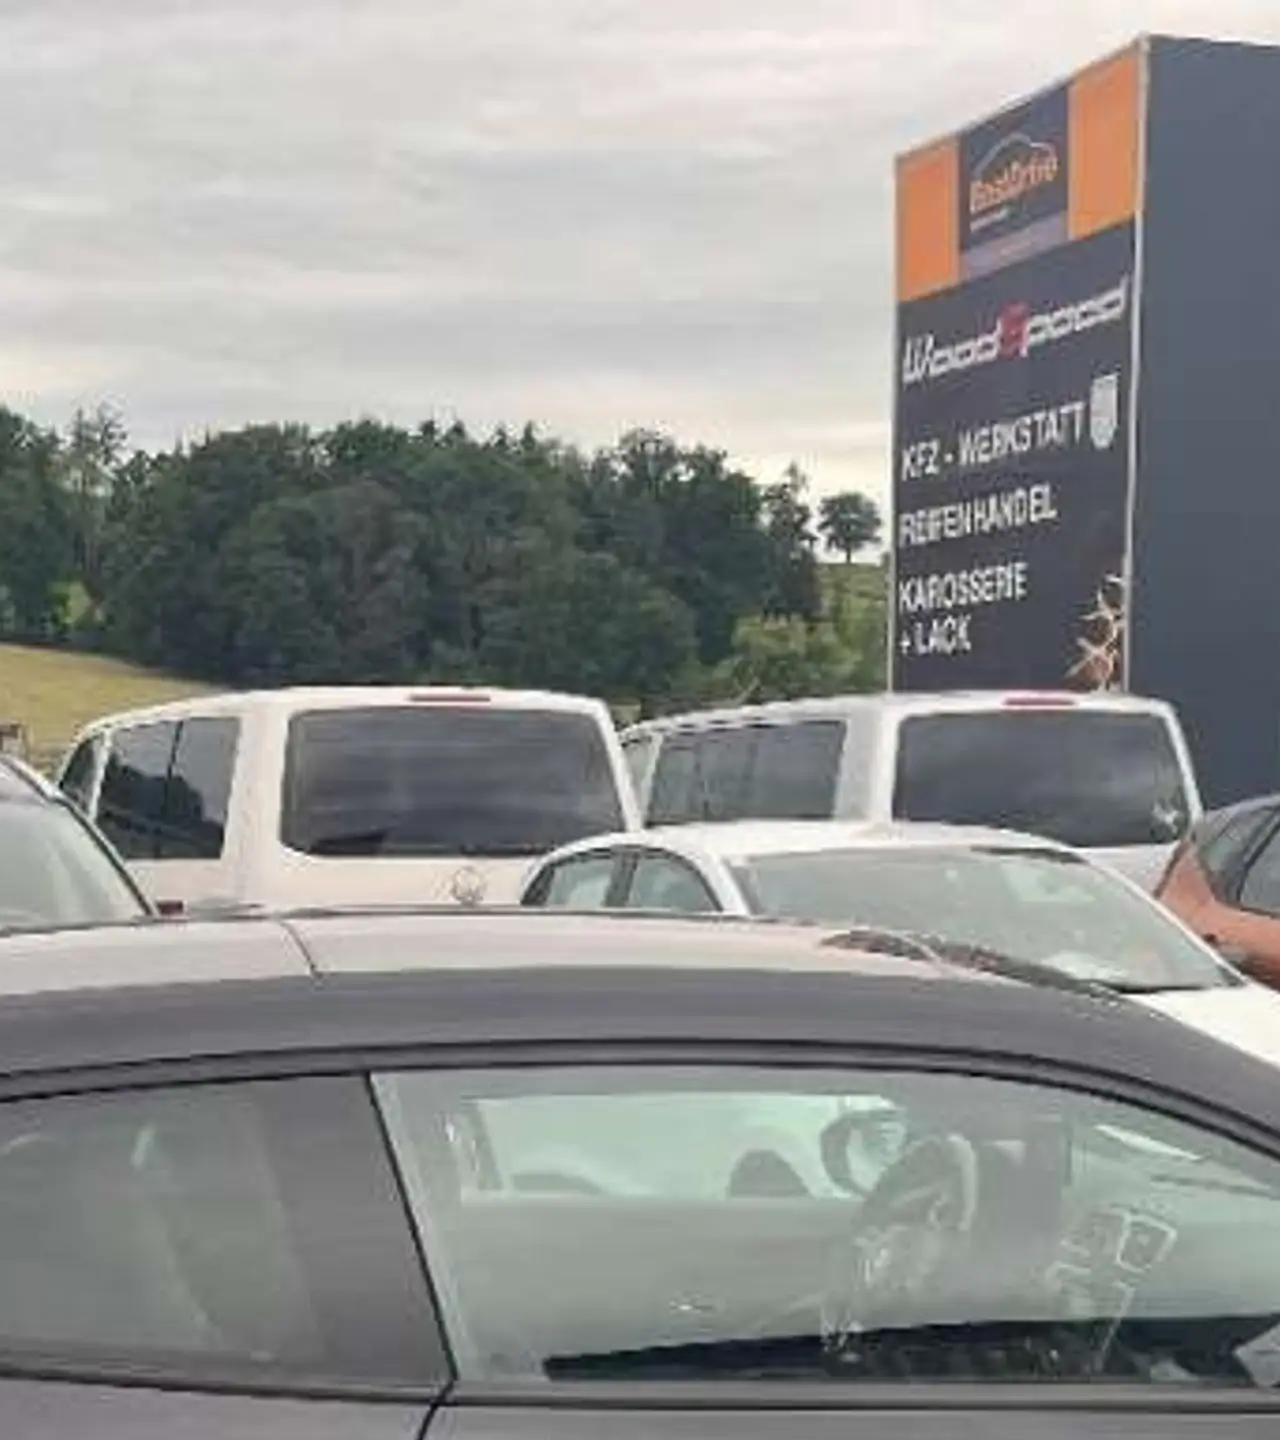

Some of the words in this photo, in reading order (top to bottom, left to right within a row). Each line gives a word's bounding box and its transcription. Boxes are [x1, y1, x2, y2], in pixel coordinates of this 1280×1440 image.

[901, 439, 940, 481] KFZ
[960, 402, 1085, 466] WERKSTATT
[899, 484, 1057, 547] REIFENHANDEL
[899, 561, 1028, 612] KAROSSERIE
[915, 614, 972, 655] LACK
